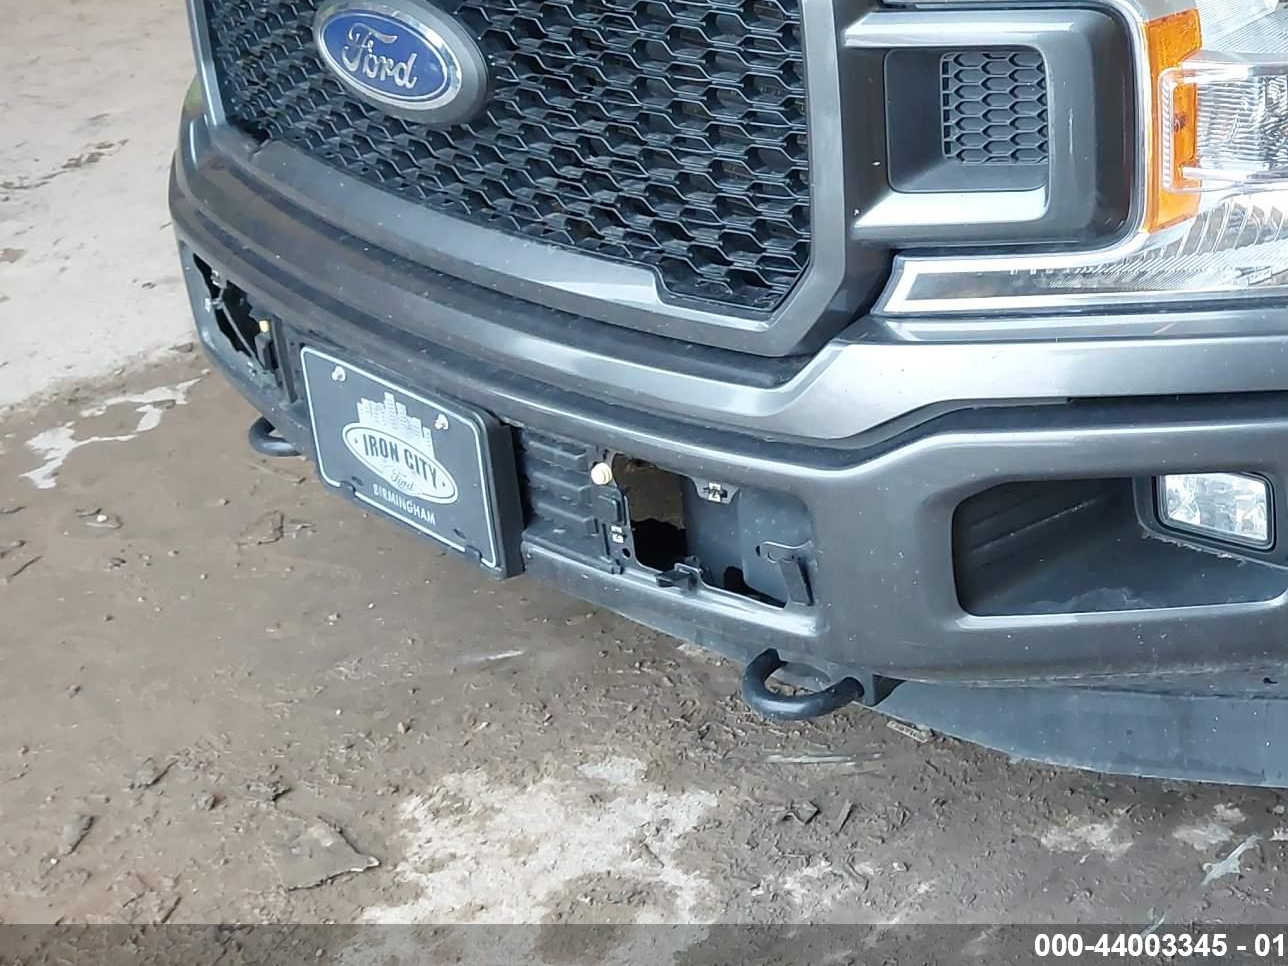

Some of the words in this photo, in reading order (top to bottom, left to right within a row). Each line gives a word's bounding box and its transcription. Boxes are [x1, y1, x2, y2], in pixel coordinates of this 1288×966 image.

[341, 22, 418, 90] Ford
[362, 433, 400, 463] IRON
[404, 448, 438, 489] CITY
[389, 469, 416, 492] Ford
[372, 483, 437, 526] BIRMINGHAM
